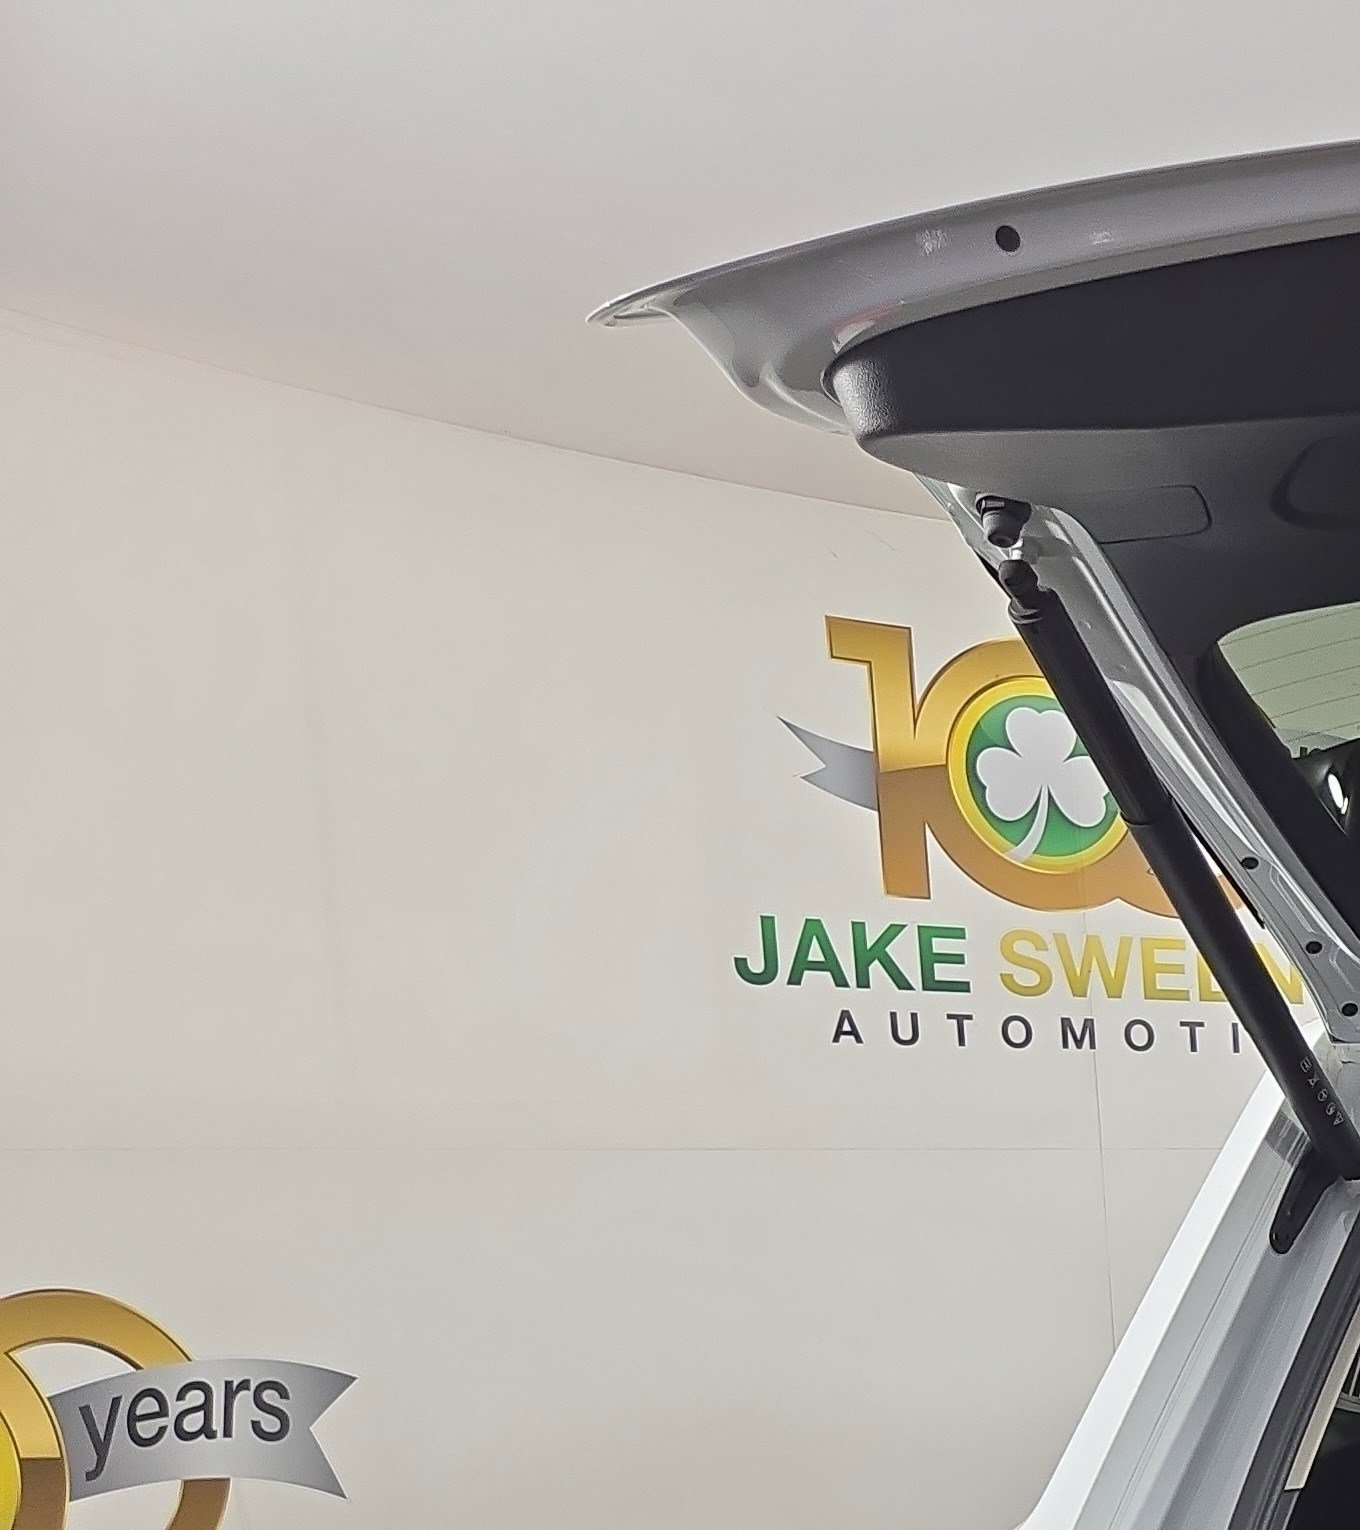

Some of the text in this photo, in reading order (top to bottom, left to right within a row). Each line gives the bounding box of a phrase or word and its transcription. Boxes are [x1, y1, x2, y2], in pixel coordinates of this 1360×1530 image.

[734, 915, 971, 993] JAKE
[832, 1009, 1240, 1054] AUTOMOTI
[80, 1376, 292, 1482] years
